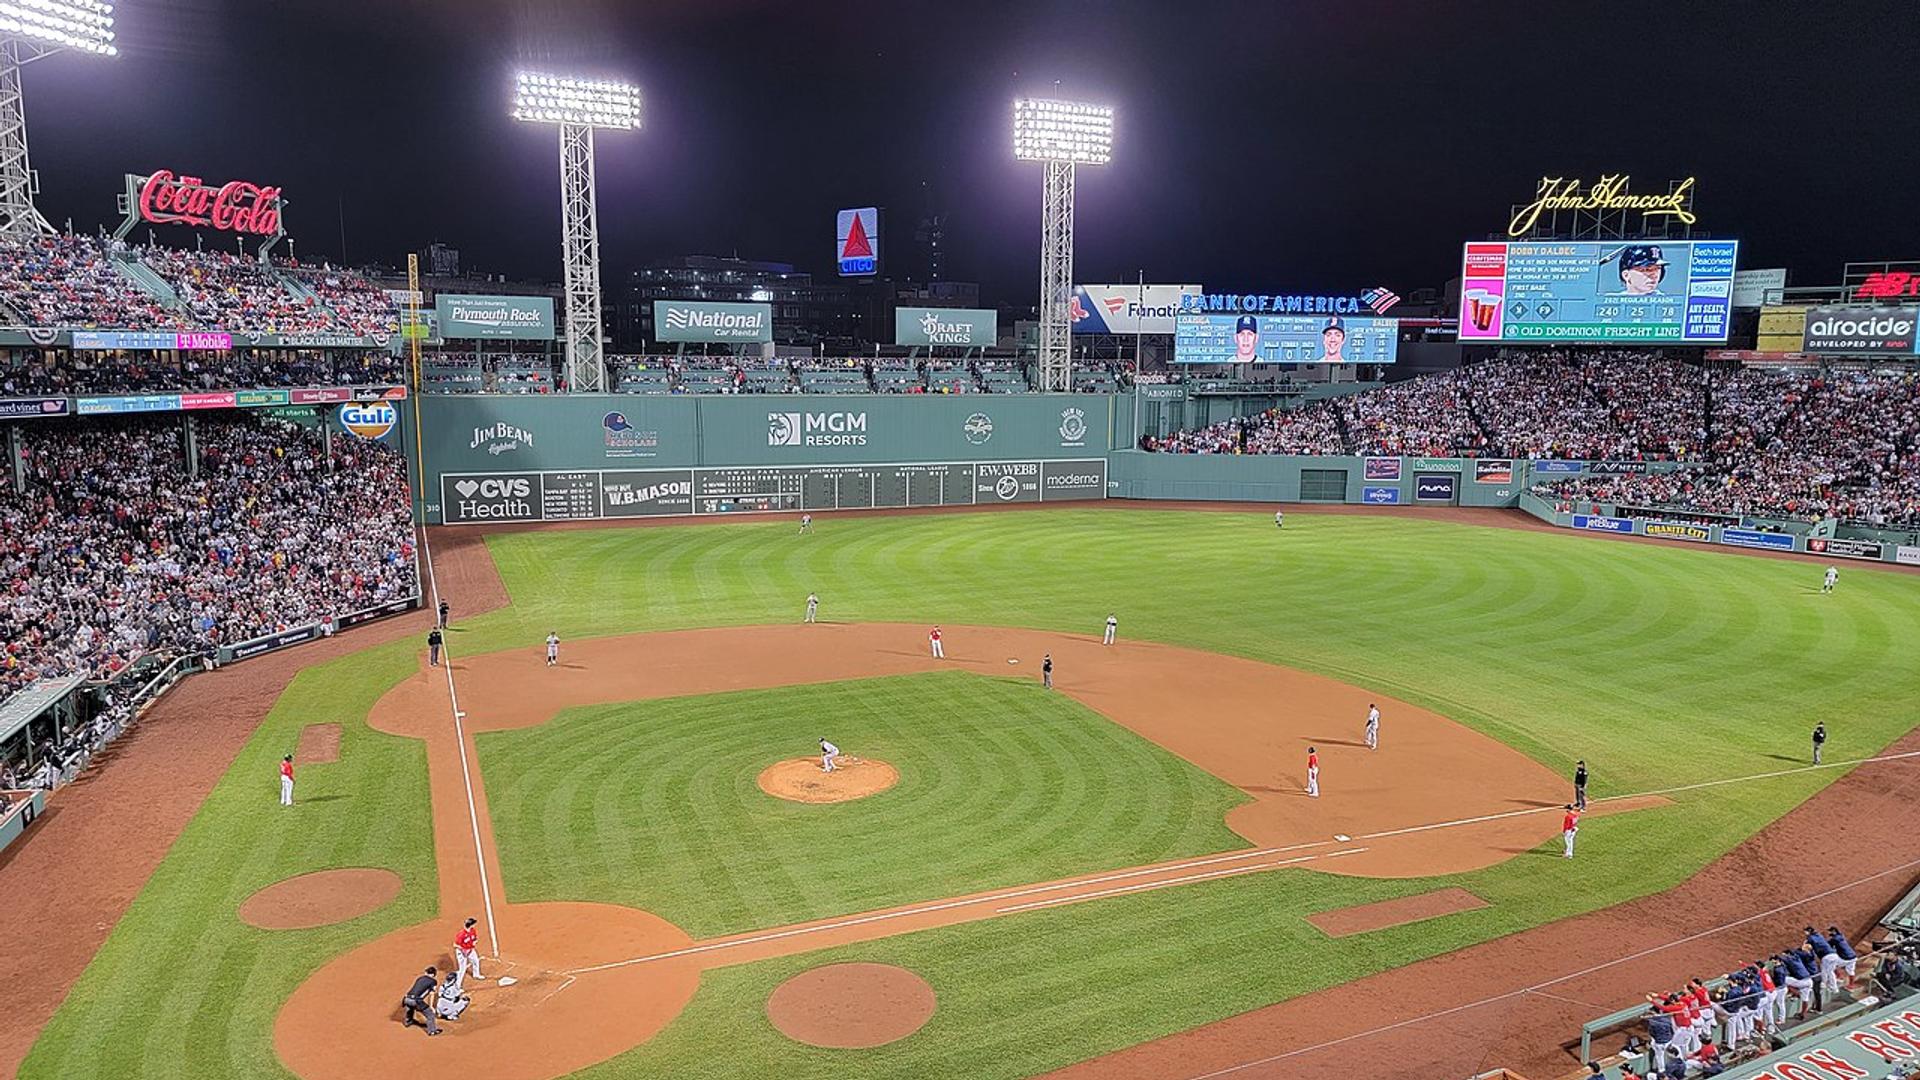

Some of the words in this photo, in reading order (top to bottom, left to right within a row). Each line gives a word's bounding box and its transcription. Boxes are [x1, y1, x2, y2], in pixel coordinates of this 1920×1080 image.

[140, 170, 282, 235] Coca-Cola
[1508, 177, 1588, 236] John
[1585, 175, 1696, 223] Hancock
[1511, 247, 1539, 255] BOBBY
[1541, 247, 1576, 255] DALBEC
[1694, 248, 1712, 256] Beth
[1713, 248, 1733, 256] Israel
[841, 259, 873, 272] CITGO
[1693, 257, 1732, 265] Deaconess
[1180, 294, 1239, 311] BANK
[1242, 295, 1267, 311] OF
[1272, 295, 1359, 314] AMERICA
[1690, 305, 1702, 313] ANY
[452, 307, 508, 321] Plymouth
[510, 308, 540, 321] Rock
[1631, 307, 1644, 316] 25
[1662, 307, 1674, 316] 78
[688, 310, 762, 329] National
[1690, 315, 1702, 323] ANY
[923, 323, 974, 335] DRAFT
[1521, 327, 1543, 336] OLD
[1546, 327, 1601, 336] DOMINION
[1604, 326, 1652, 337] FREIGHT
[1655, 326, 1680, 336] LINE
[1691, 325, 1703, 334] ANY
[1811, 317, 1911, 336] airocide
[714, 328, 729, 336] Car
[730, 328, 759, 337] Rental
[929, 332, 971, 344] KINGS
[291, 336, 314, 346] BLACK
[315, 335, 336, 346] LIVES
[337, 335, 363, 346] MATTER
[1809, 340, 1866, 348] DEVELOPED
[1304, 350, 1311, 360] 2
[1148, 389, 1184, 398] ABIOMED
[16, 403, 41, 412] vines
[343, 409, 394, 424] Gulf
[806, 412, 867, 433] MGM
[470, 426, 496, 449] JIM
[497, 422, 534, 448] BEAM
[806, 435, 867, 446] RESORTS
[1003, 464, 1038, 476] WEBB
[1047, 473, 1100, 486] moderna
[480, 478, 531, 498] CVS
[978, 484, 994, 493] Since
[426, 504, 441, 513] 310
[458, 500, 532, 518] Health
[1647, 525, 1685, 535] GRANITE
[1688, 528, 1708, 539] CITY
